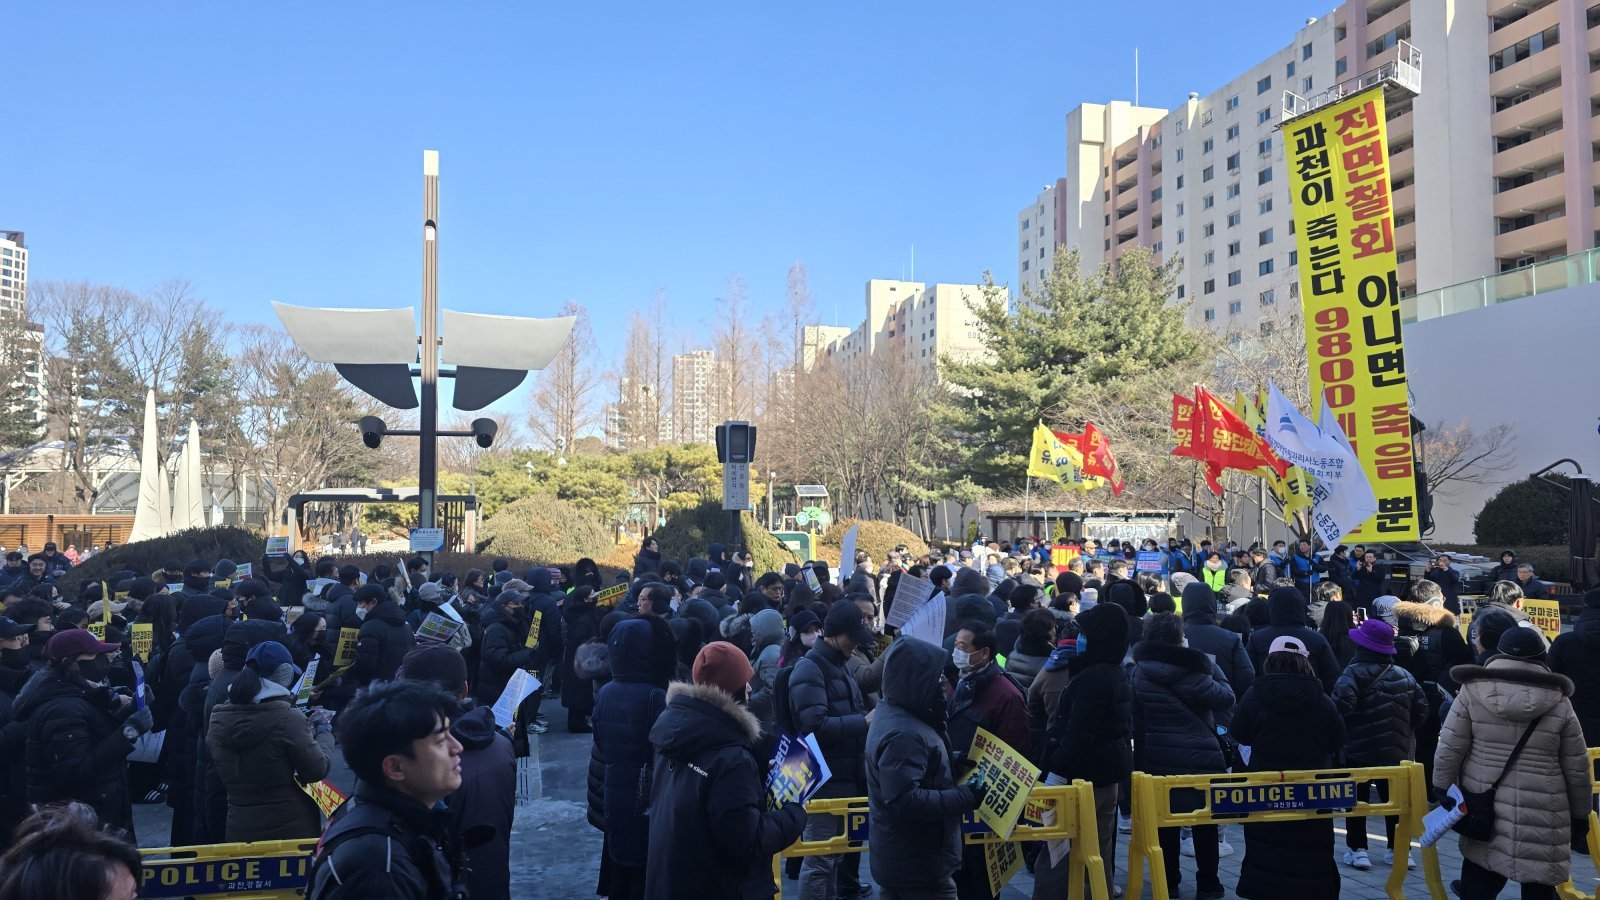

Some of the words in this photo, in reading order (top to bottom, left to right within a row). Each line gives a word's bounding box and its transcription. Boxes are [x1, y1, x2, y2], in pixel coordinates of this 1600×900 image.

[1293, 121, 1334, 206] 과천이
[1334, 100, 1394, 260] 전면철회
[1306, 213, 1346, 296] 죽는다
[1357, 270, 1406, 388] 아니면
[1371, 402, 1412, 480] 죽음
[1376, 496, 1413, 533] 뿐
[1521, 606, 1559, 617] 경마공원
[975, 734, 1004, 762] 말산업
[1003, 756, 1034, 788] 숨통끊는
[979, 756, 1020, 802] 주택공급
[1214, 787, 1295, 804] POLICE
[1307, 784, 1354, 800] LINE
[141, 861, 260, 886] POLICE
[279, 859, 306, 877] LI
[228, 880, 272, 890] 과천경찰서
